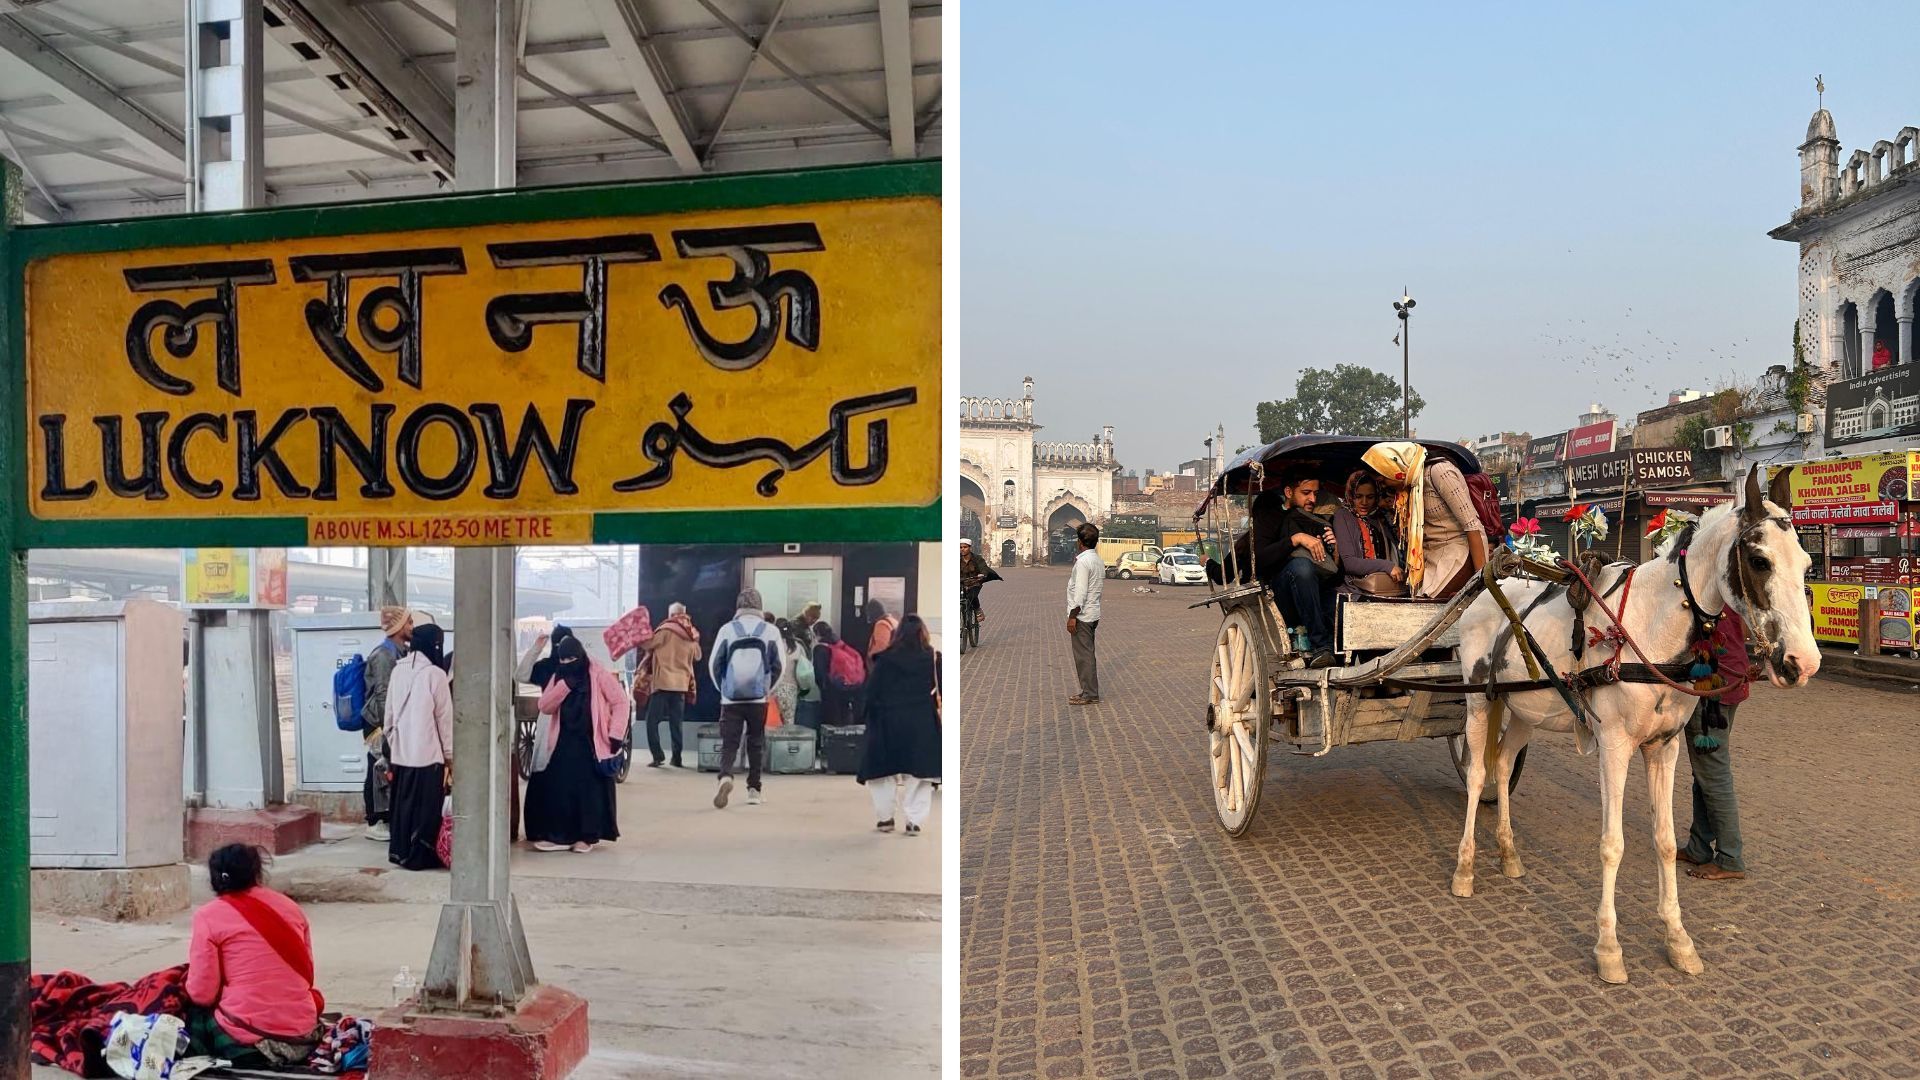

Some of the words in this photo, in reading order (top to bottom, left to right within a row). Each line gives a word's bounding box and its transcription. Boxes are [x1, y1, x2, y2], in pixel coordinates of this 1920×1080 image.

[1867, 369, 1910, 386] Advertising
[39, 398, 596, 501] LUCKNOW
[1636, 450, 1692, 464] CHICKEN
[1639, 465, 1691, 479] SAMOSA
[1801, 460, 1863, 476] BURHANPUR
[1812, 473, 1853, 486] FAMOUS
[1797, 486, 1834, 498] KHOWA
[1836, 483, 1871, 496] JALEBI
[1830, 504, 1852, 518] जलेबी
[1852, 506, 1871, 517] मावा
[1871, 501, 1895, 516] जलेबी
[314, 520, 370, 540] ABOVE
[485, 517, 553, 538] METRE
[1854, 528, 1883, 538] Chicken
[1817, 626, 1846, 638] KHOWA
